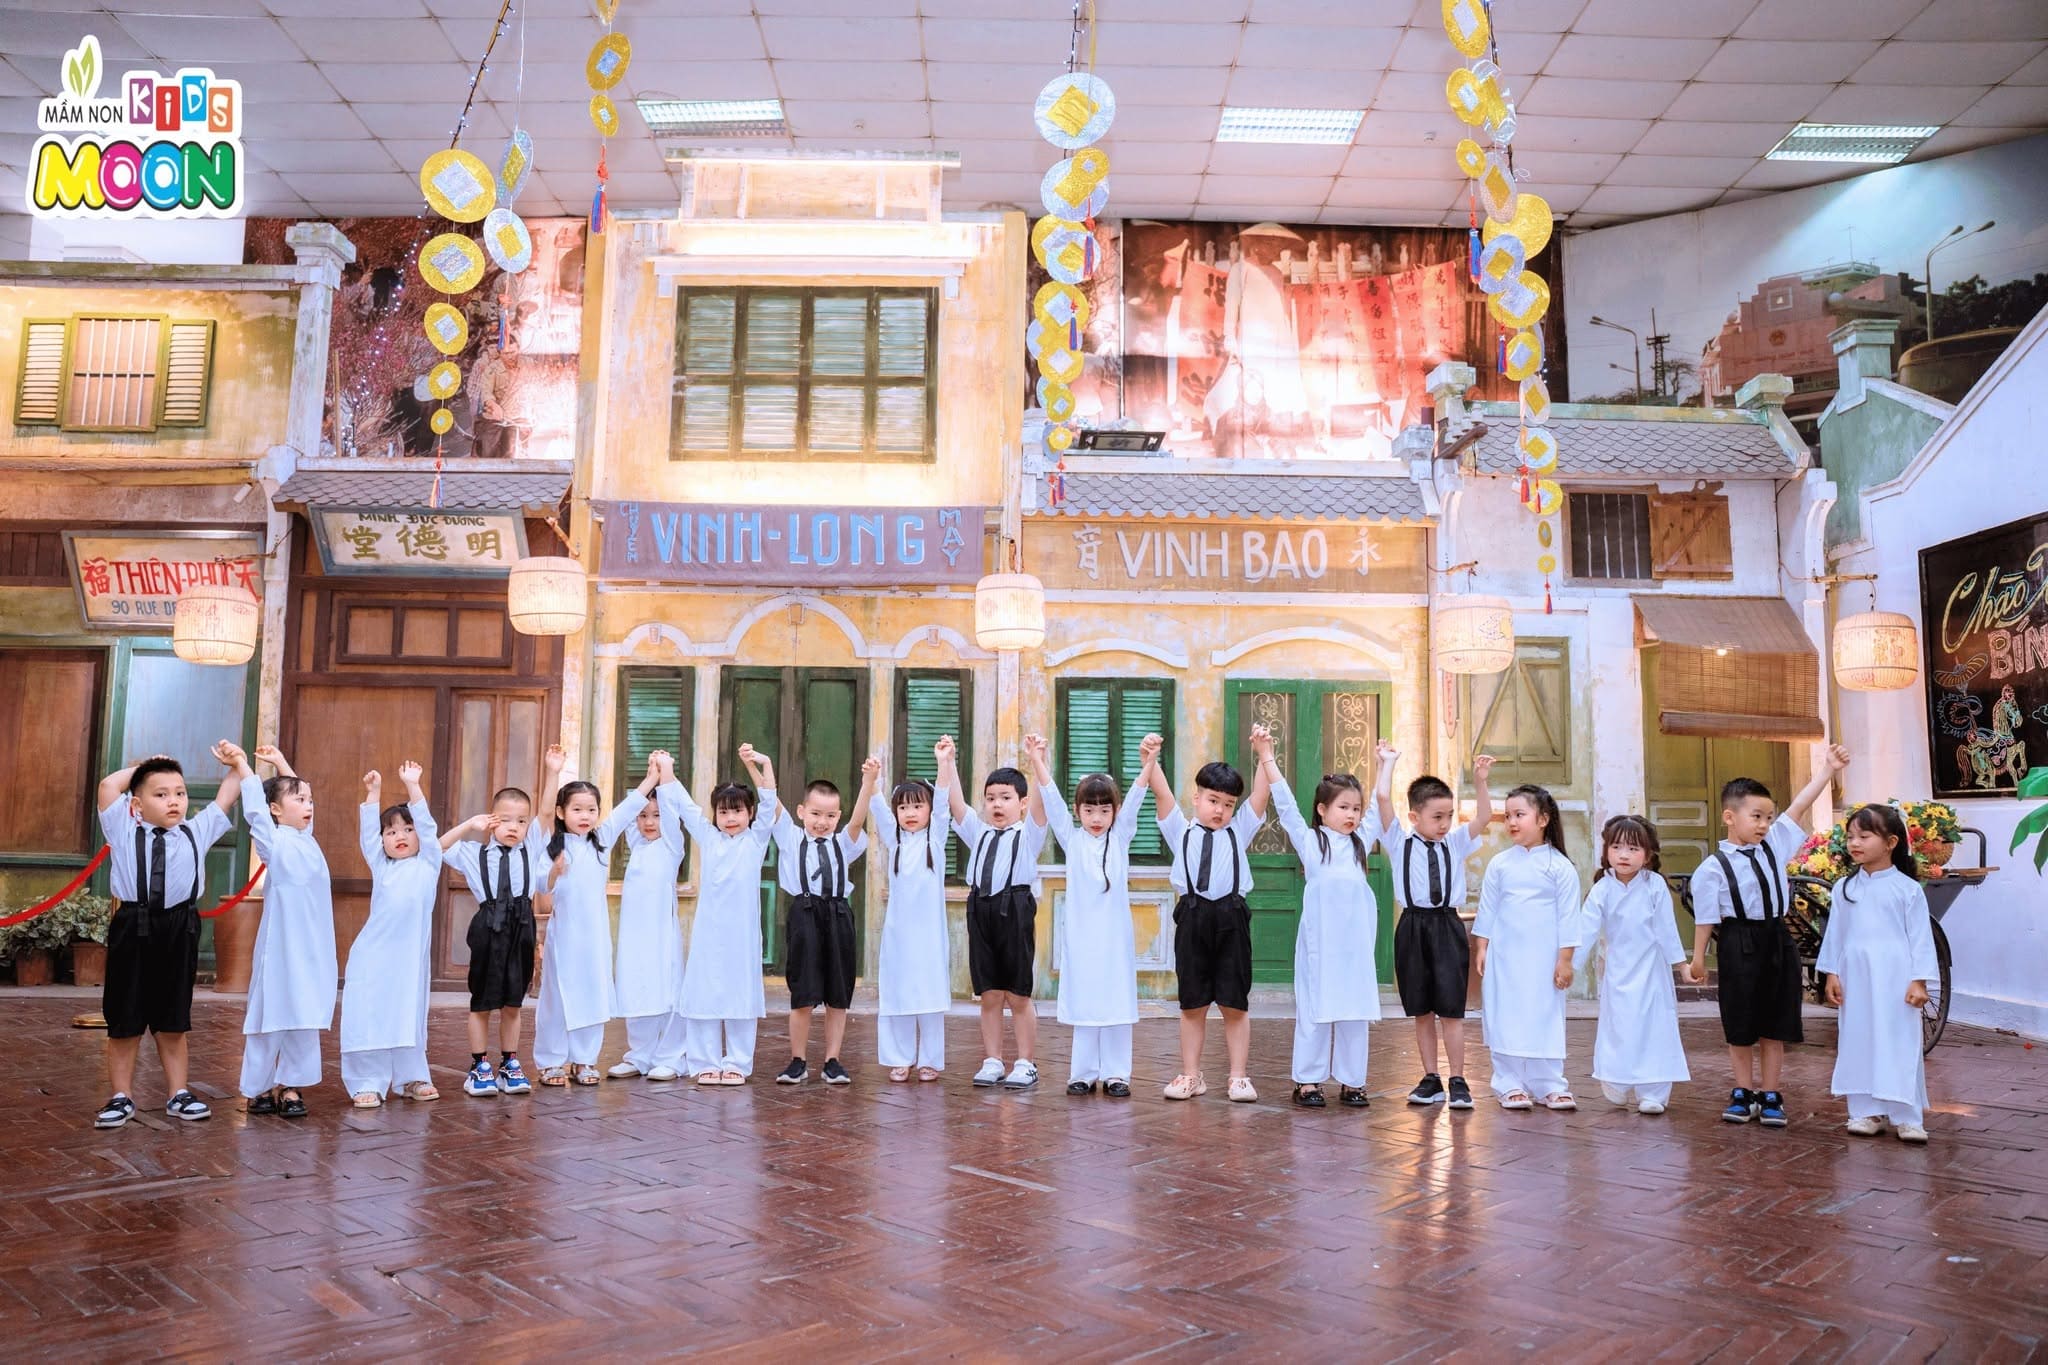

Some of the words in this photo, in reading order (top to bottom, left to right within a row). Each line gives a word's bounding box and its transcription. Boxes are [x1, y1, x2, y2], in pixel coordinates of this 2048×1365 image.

[650, 512, 926, 566] VINH-LONG
[938, 509, 965, 566] MAY
[1116, 530, 1229, 578] VINH
[1242, 528, 1329, 580] BAO
[112, 599, 130, 615] 90
[136, 600, 158, 616] RUE
